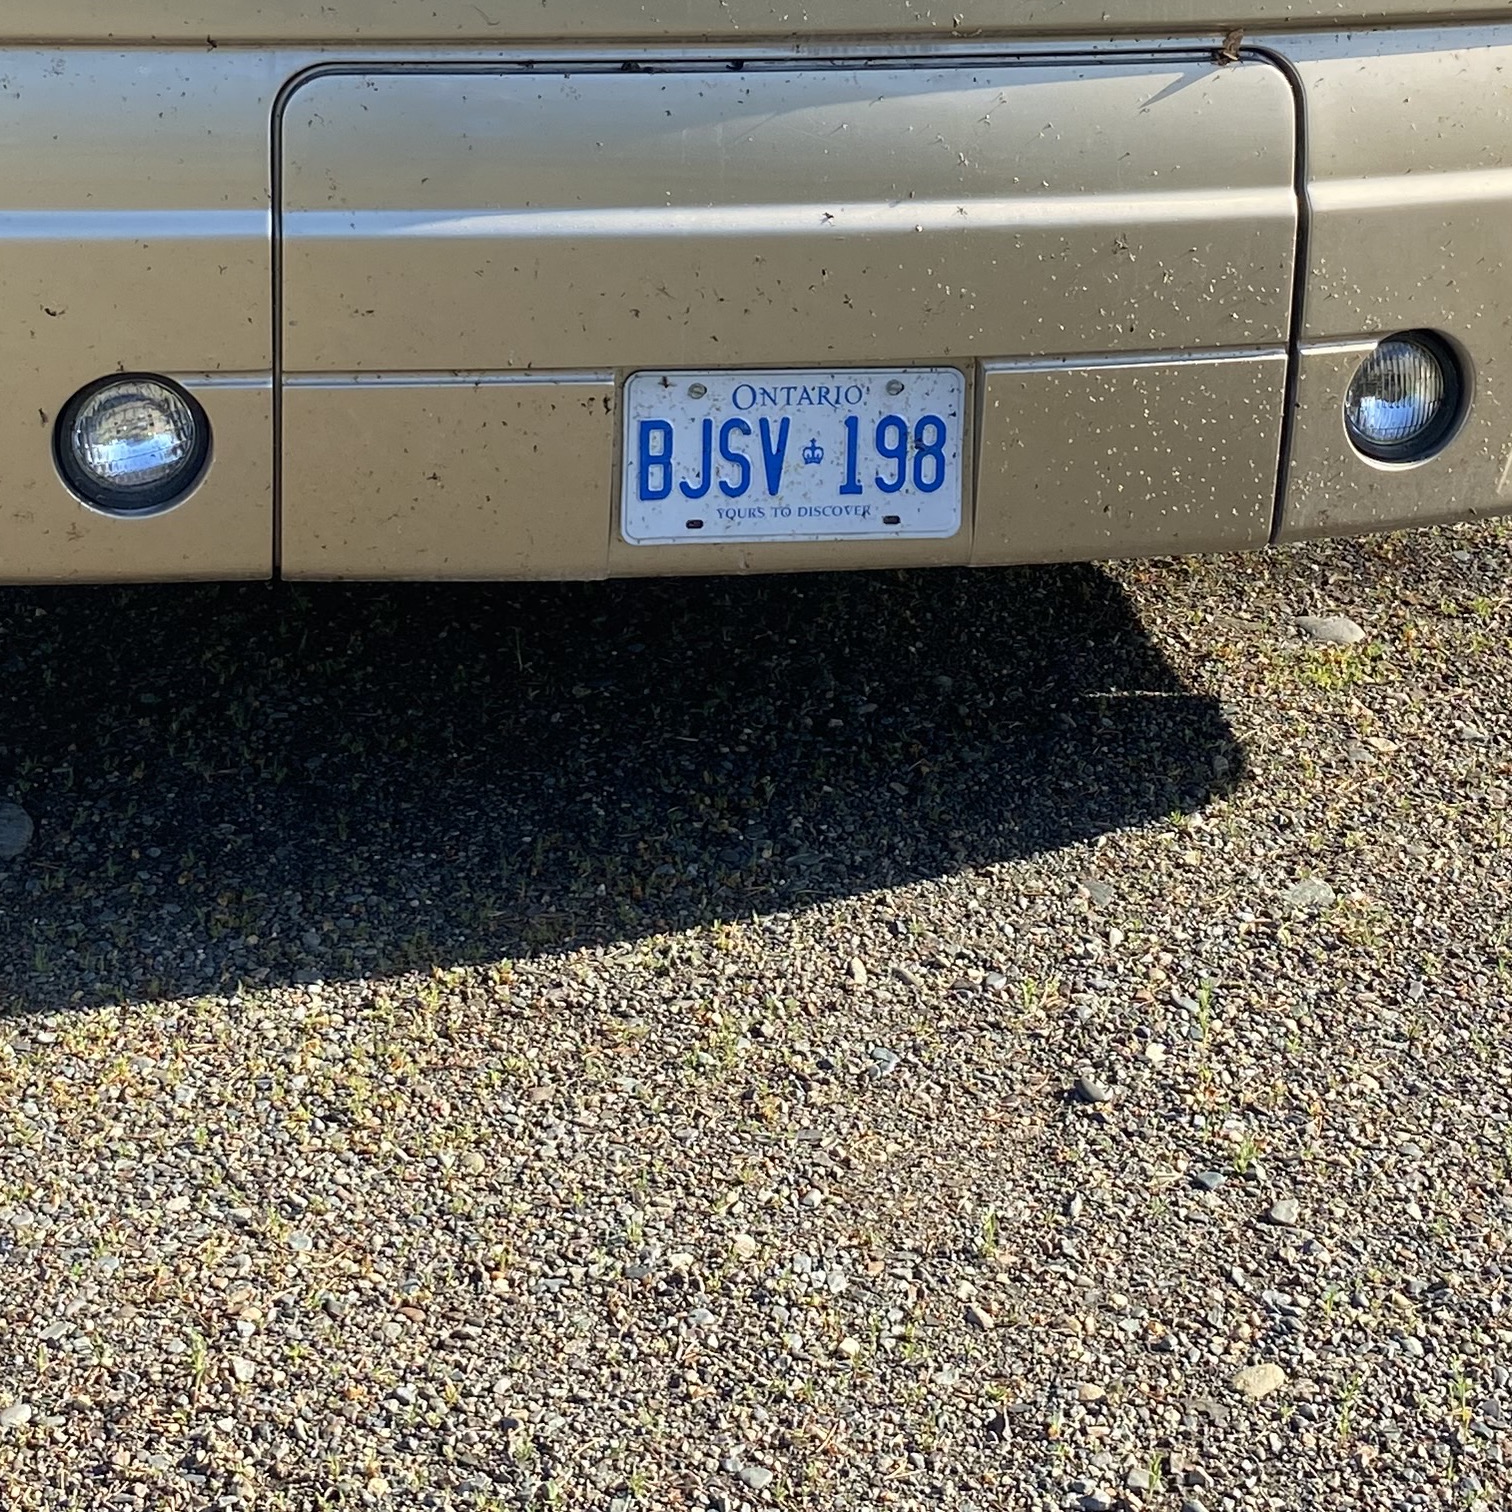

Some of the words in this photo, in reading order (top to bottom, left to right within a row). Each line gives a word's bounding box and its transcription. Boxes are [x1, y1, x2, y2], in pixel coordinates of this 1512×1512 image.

[732, 383, 863, 410] ONTARIO
[639, 416, 790, 501] BJSV
[839, 414, 947, 494] 198
[716, 507, 766, 520] YOURS
[771, 505, 792, 517] TO
[797, 504, 871, 519] DISCOVER
